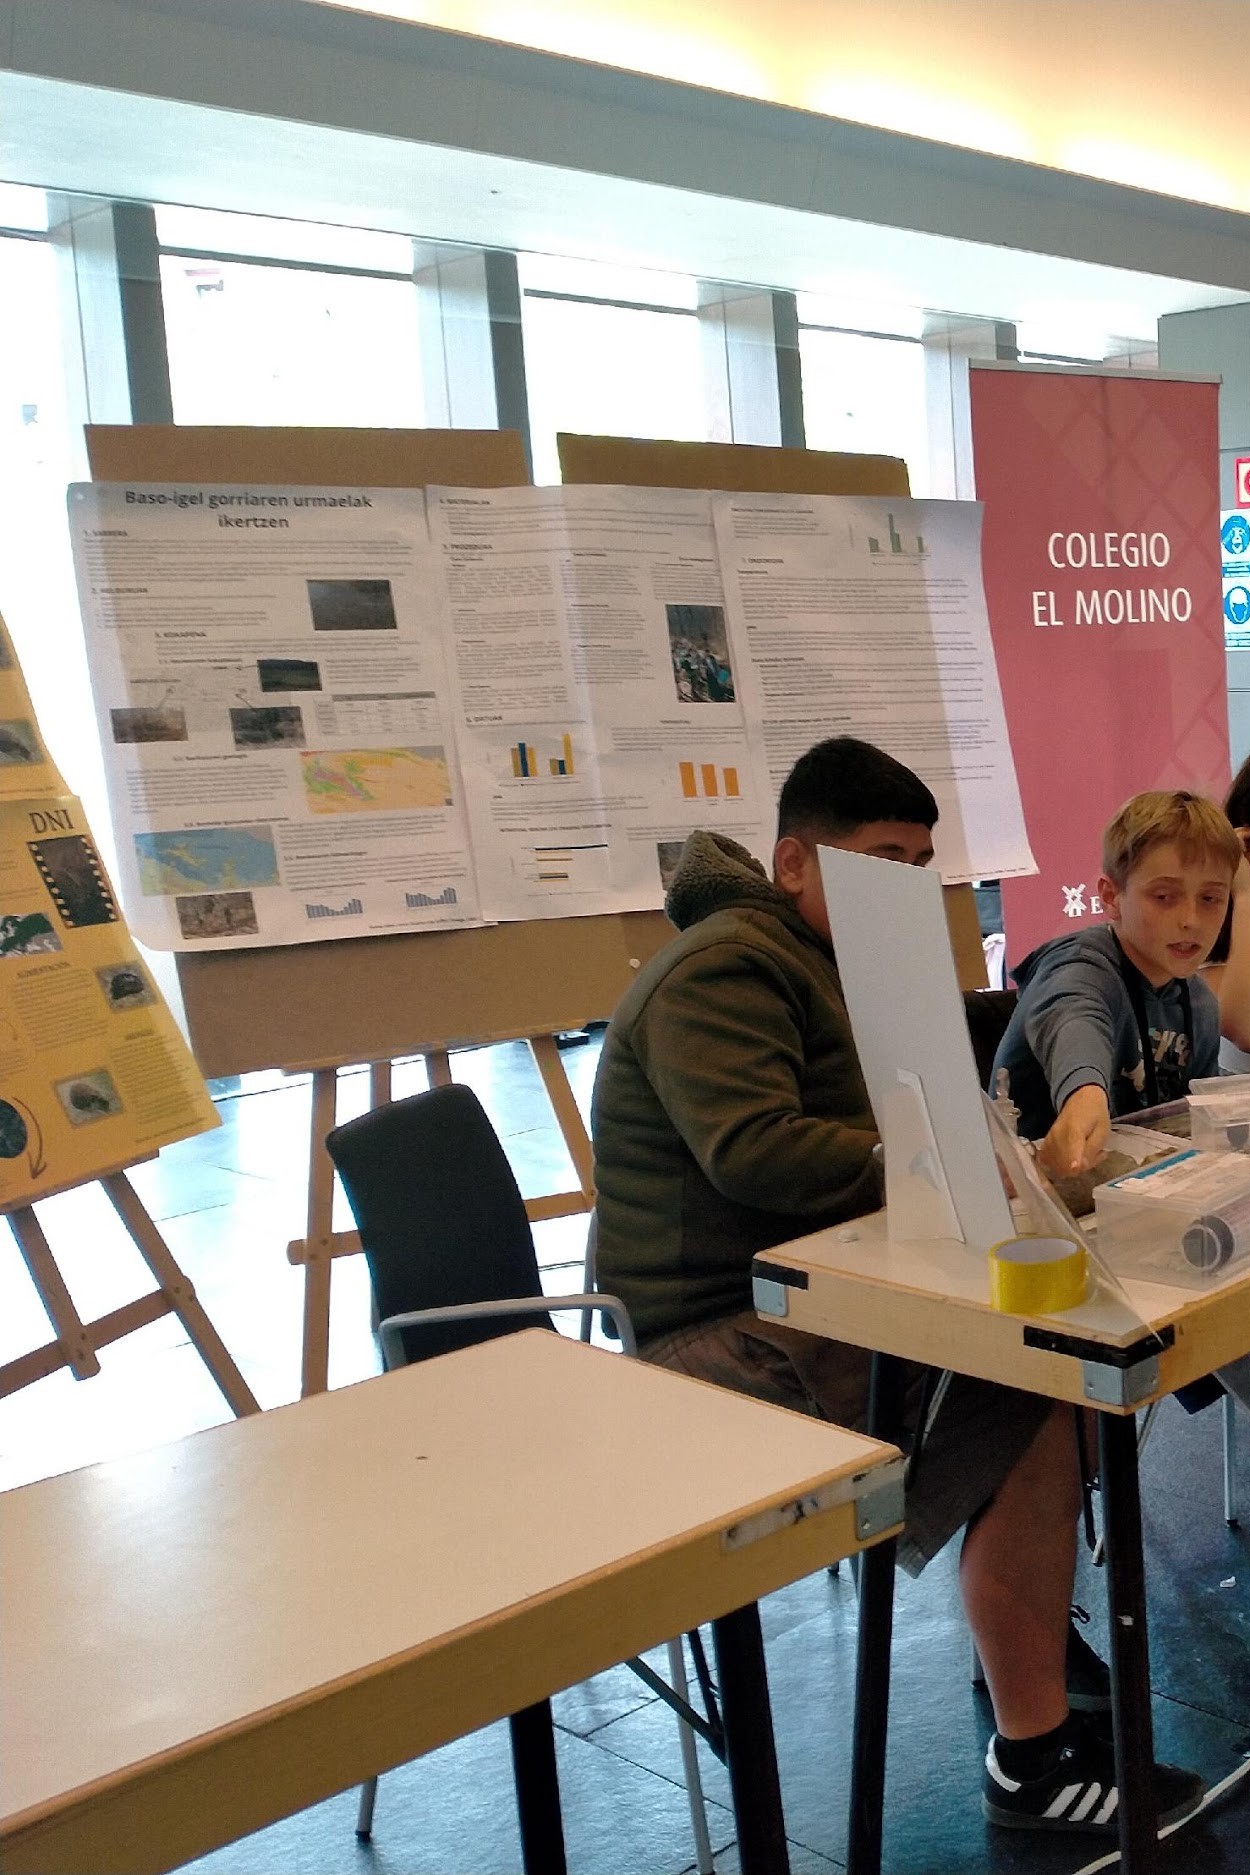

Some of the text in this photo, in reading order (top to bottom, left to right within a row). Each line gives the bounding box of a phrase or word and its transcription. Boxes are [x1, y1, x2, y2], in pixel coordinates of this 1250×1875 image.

[125, 490, 373, 509] Baso-igel gorriaren urmaelak
[218, 514, 290, 529] ikertzen
[1048, 532, 1171, 568] COLEGIO
[1032, 587, 1193, 627] EL MOLINO
[29, 809, 75, 834] DNI
